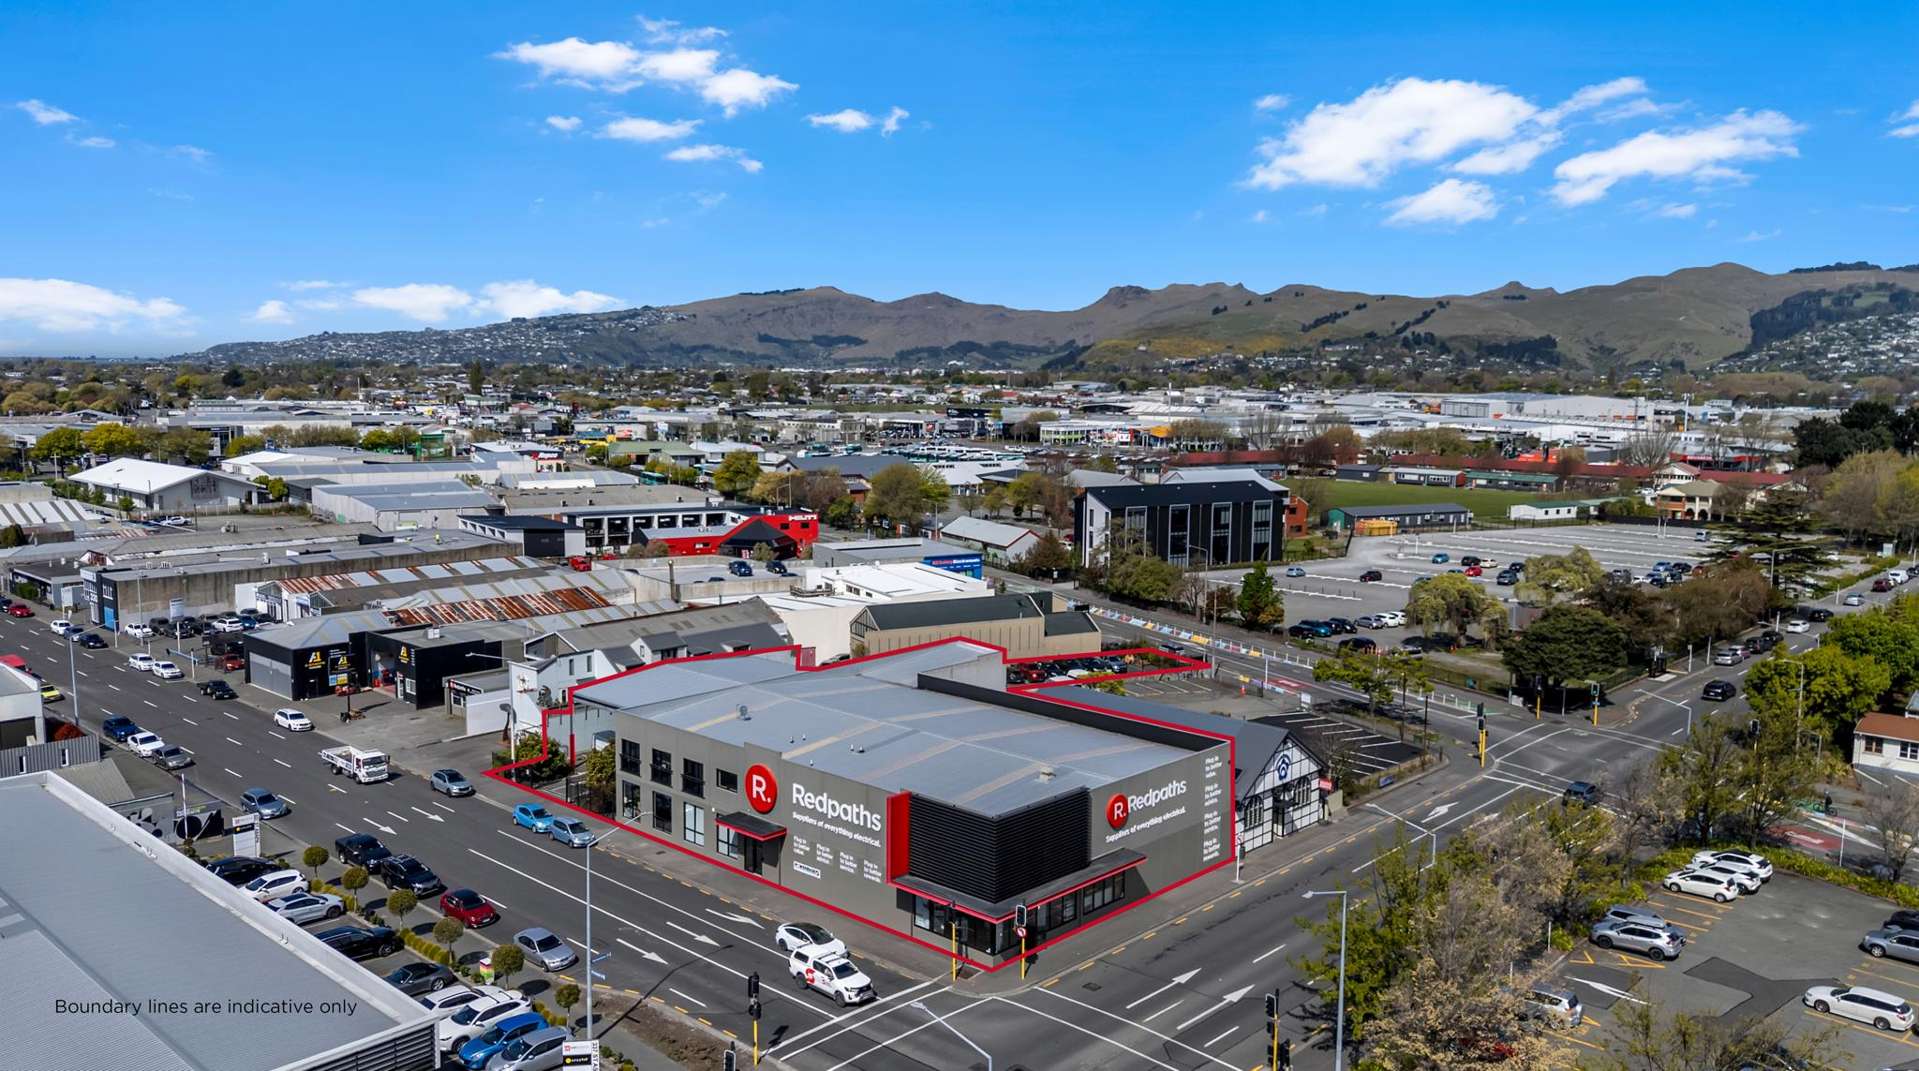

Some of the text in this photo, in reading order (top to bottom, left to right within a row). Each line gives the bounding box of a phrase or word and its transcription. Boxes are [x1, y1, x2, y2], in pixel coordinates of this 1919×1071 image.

[752, 774, 771, 803] R.
[1127, 780, 1187, 813] Redpaths
[792, 782, 882, 832] Redpaths
[792, 811, 882, 848] Suppliers of everything electrical.
[1105, 828, 1130, 843] Suppliers
[1130, 824, 1137, 833] of
[1137, 815, 1163, 831] everything
